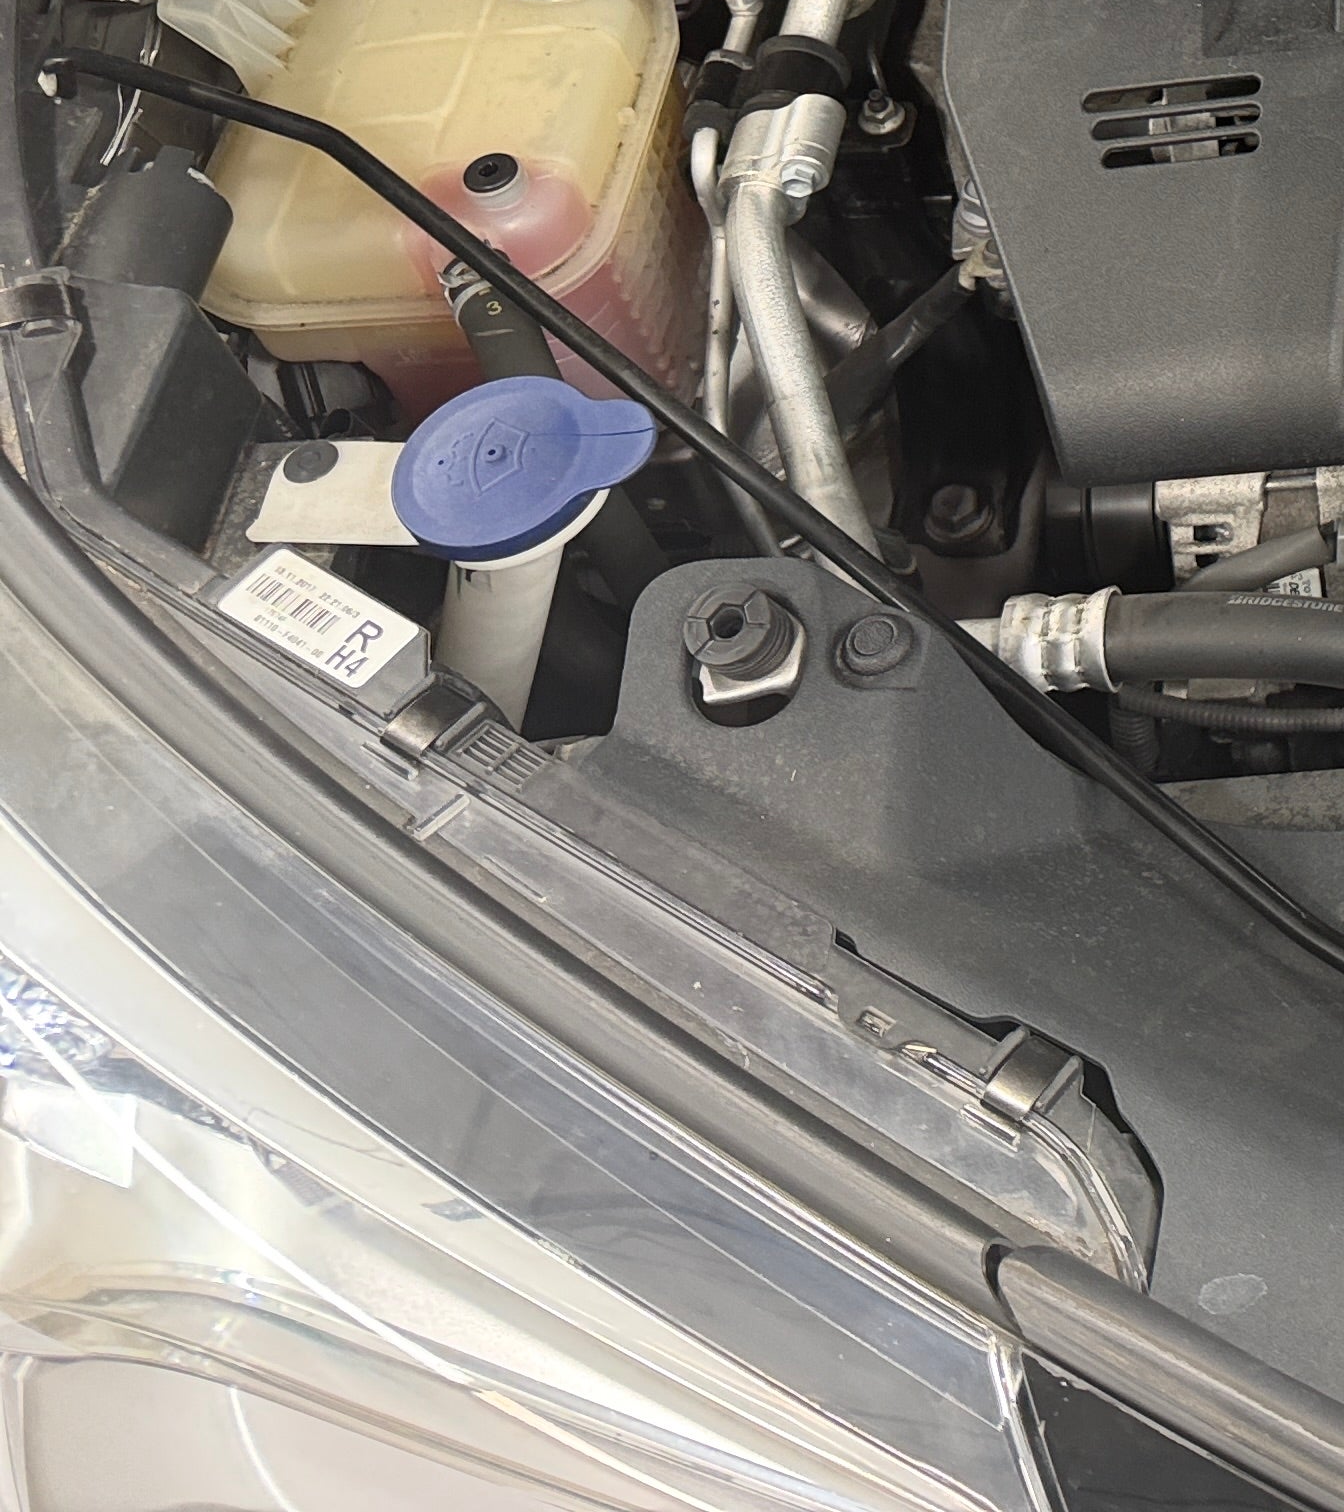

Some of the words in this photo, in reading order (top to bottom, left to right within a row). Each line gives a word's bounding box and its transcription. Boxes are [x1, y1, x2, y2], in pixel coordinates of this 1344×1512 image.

[486, 300, 503, 316] 3
[1227, 595, 1344, 613] BRIDGESTONE
[343, 618, 384, 654] R
[323, 644, 370, 678] H4
